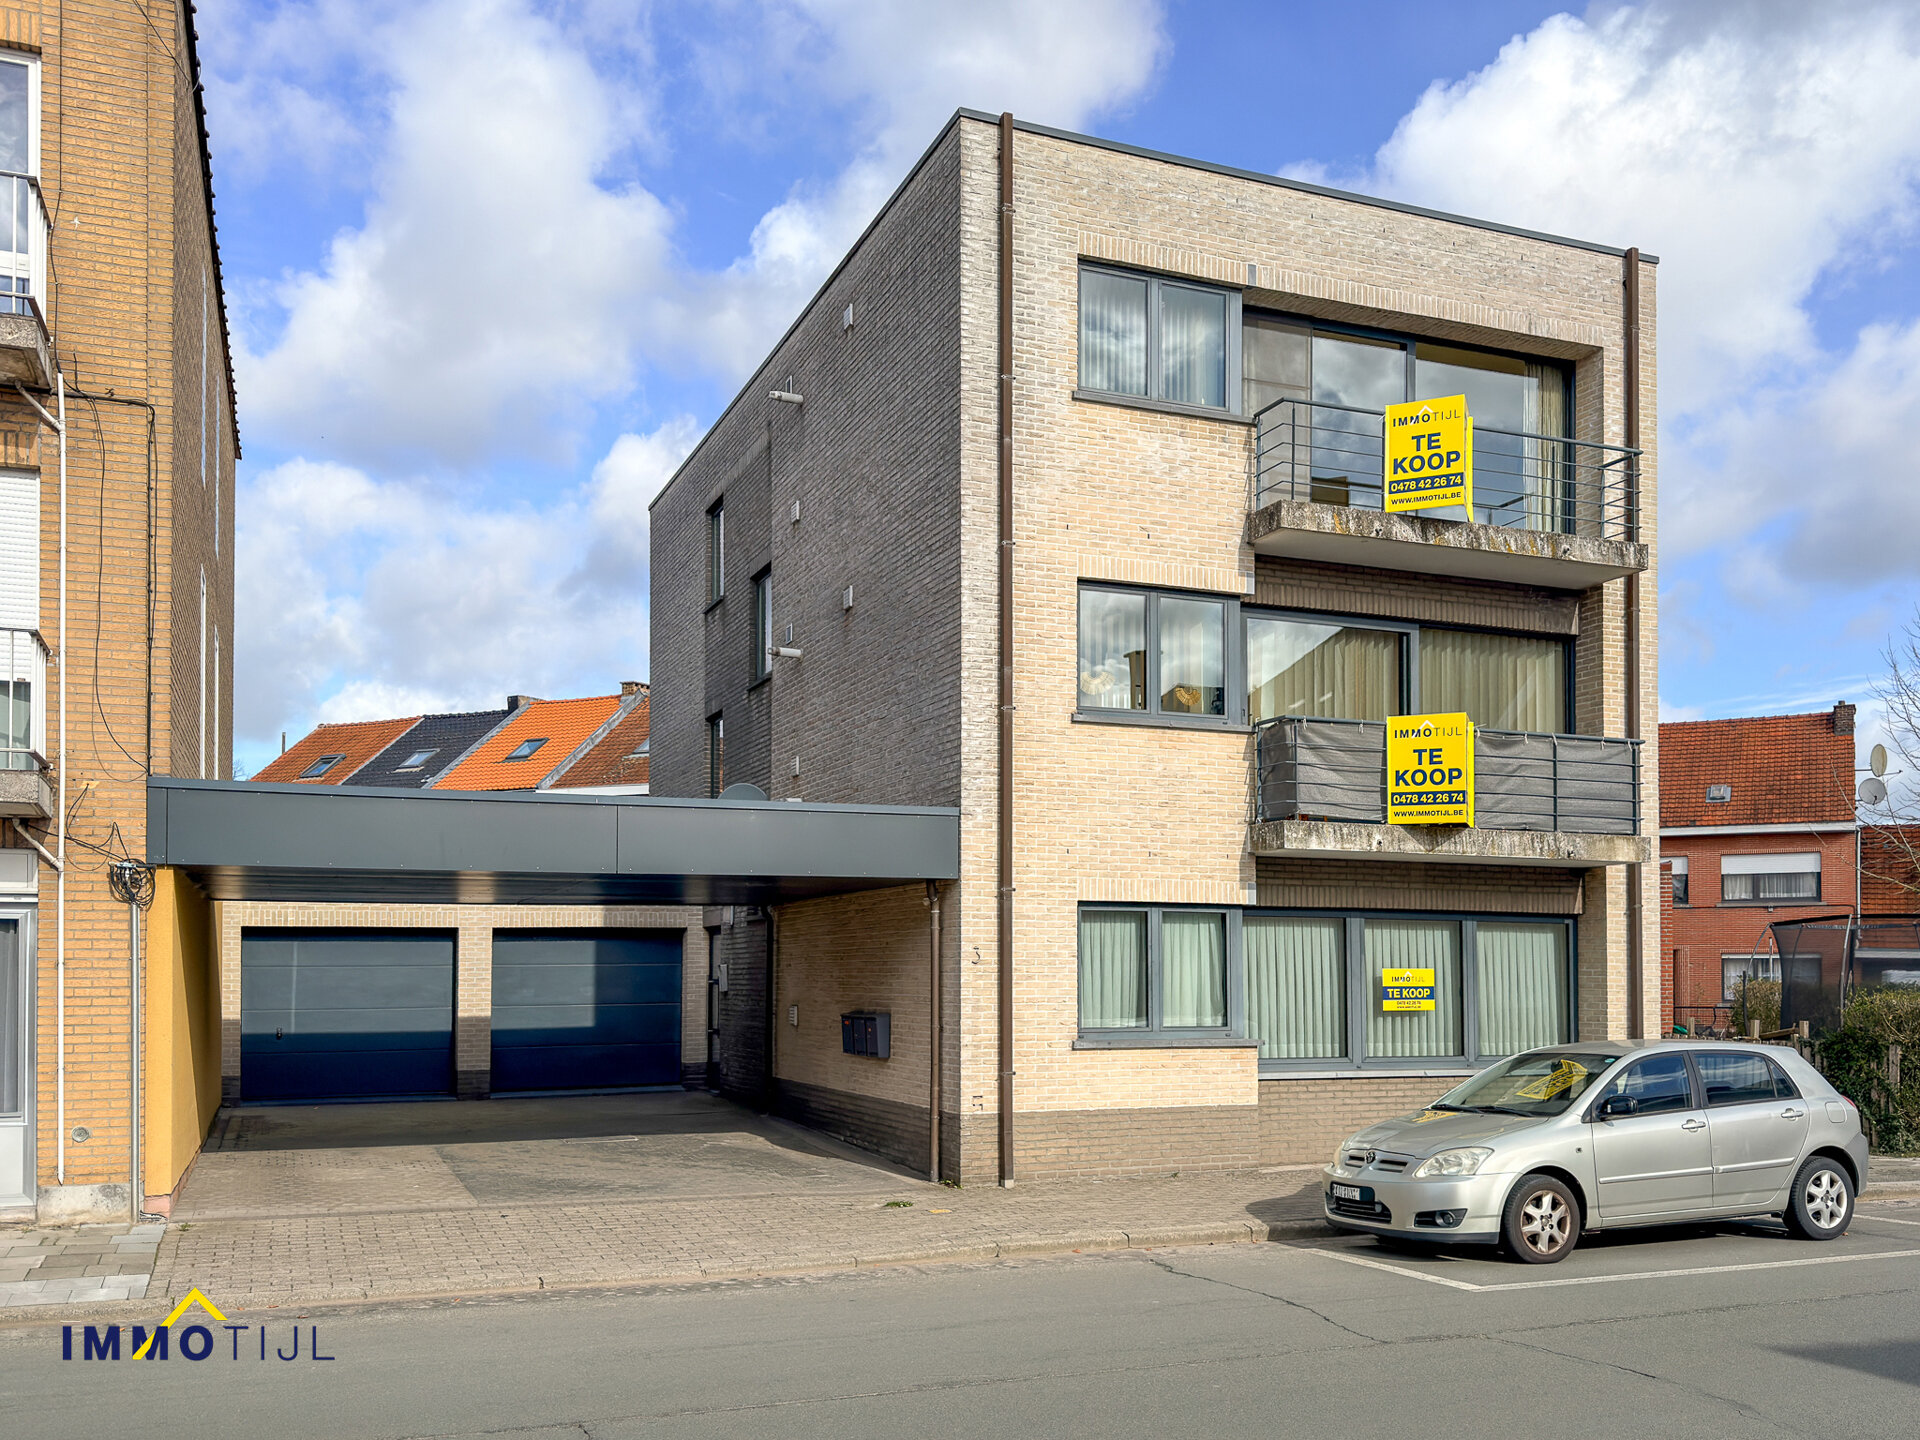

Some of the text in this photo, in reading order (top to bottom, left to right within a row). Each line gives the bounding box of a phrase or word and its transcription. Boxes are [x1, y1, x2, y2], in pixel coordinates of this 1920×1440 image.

[1393, 409, 1461, 427] IMMOTIJL
[1411, 432, 1441, 452] TE
[1393, 450, 1461, 475] KOOP
[1391, 475, 1462, 492] 0478 42 26 74
[1391, 491, 1461, 505] WWW.IMMOTIJL.BE
[1394, 726, 1462, 739] IMMOTIJL
[1413, 748, 1443, 765] TE
[1395, 768, 1463, 787] KOOP
[1393, 793, 1464, 804] 0478 42 26 74
[1394, 809, 1464, 817] WWW.IMMOTIJL.BE
[1387, 988, 1431, 998] TE KOOP
